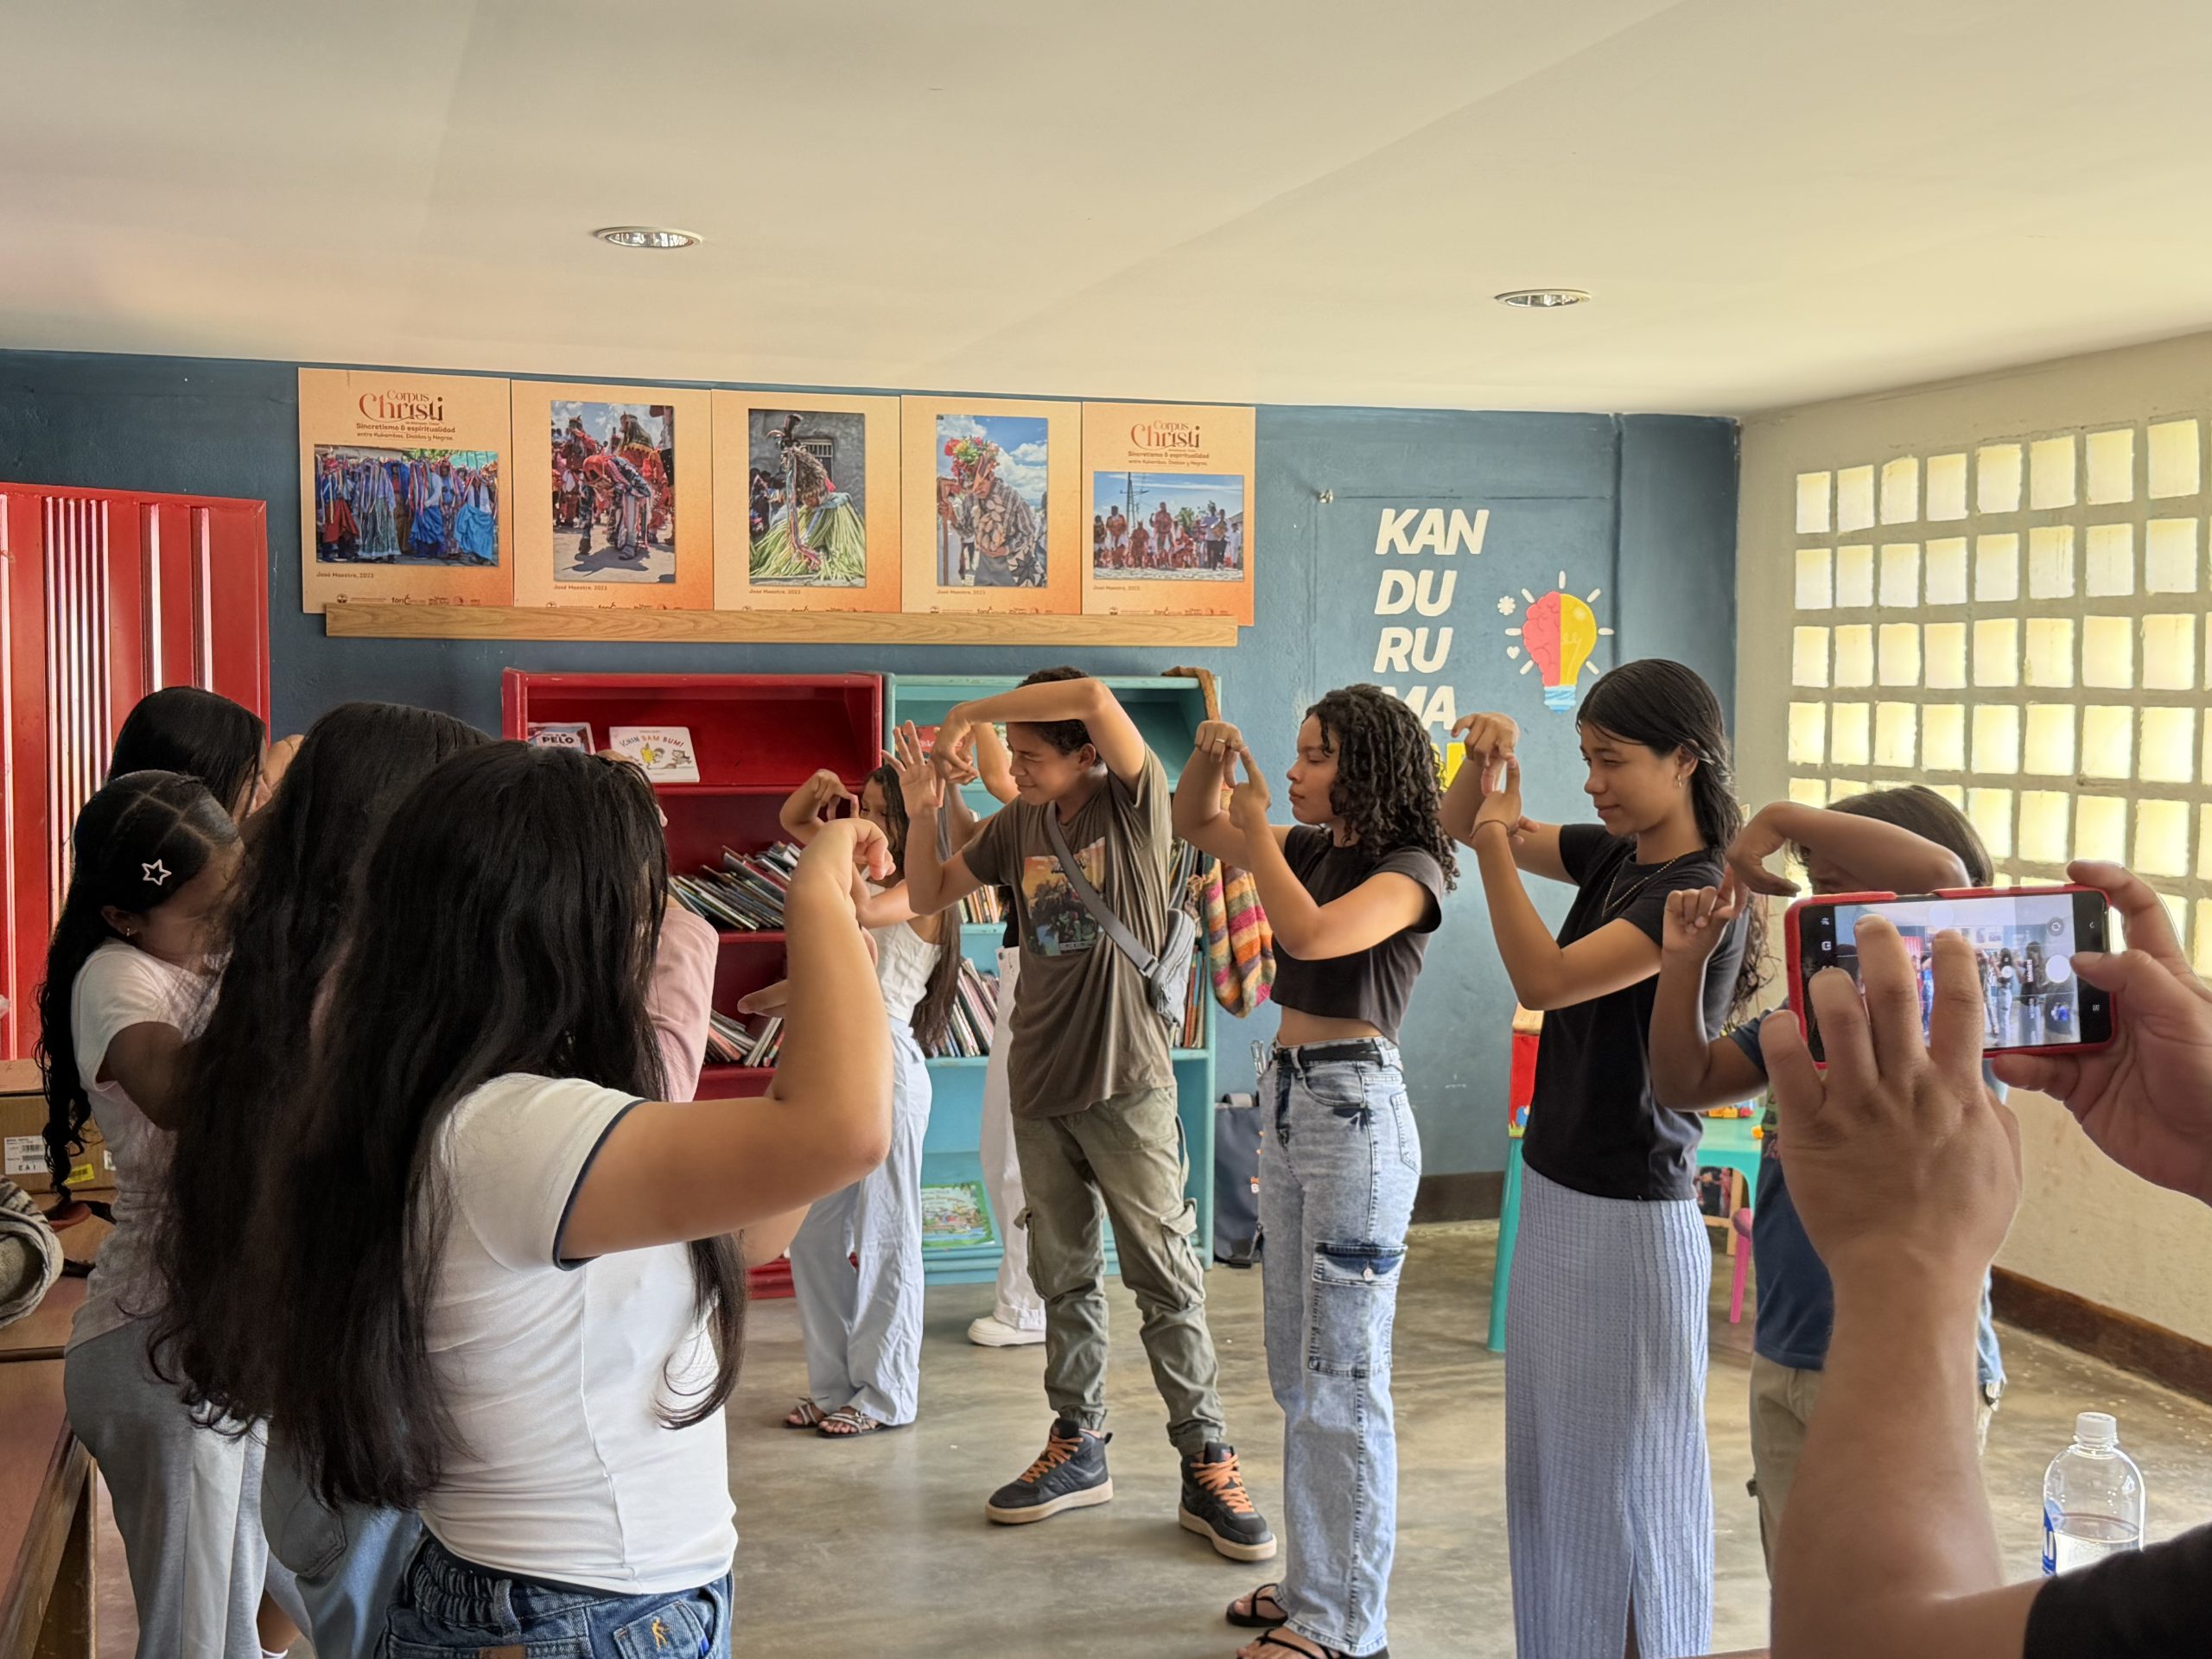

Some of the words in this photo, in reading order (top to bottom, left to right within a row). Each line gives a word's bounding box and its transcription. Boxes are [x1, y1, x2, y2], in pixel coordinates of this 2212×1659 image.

[359, 393, 443, 423] Christi
[386, 389, 429, 404] Corpus
[1130, 423, 1200, 450] Christi
[1154, 420, 1189, 432] Corpus
[1376, 508, 1490, 555] KAN
[1374, 569, 1458, 616] DU
[1373, 627, 1453, 673] RU
